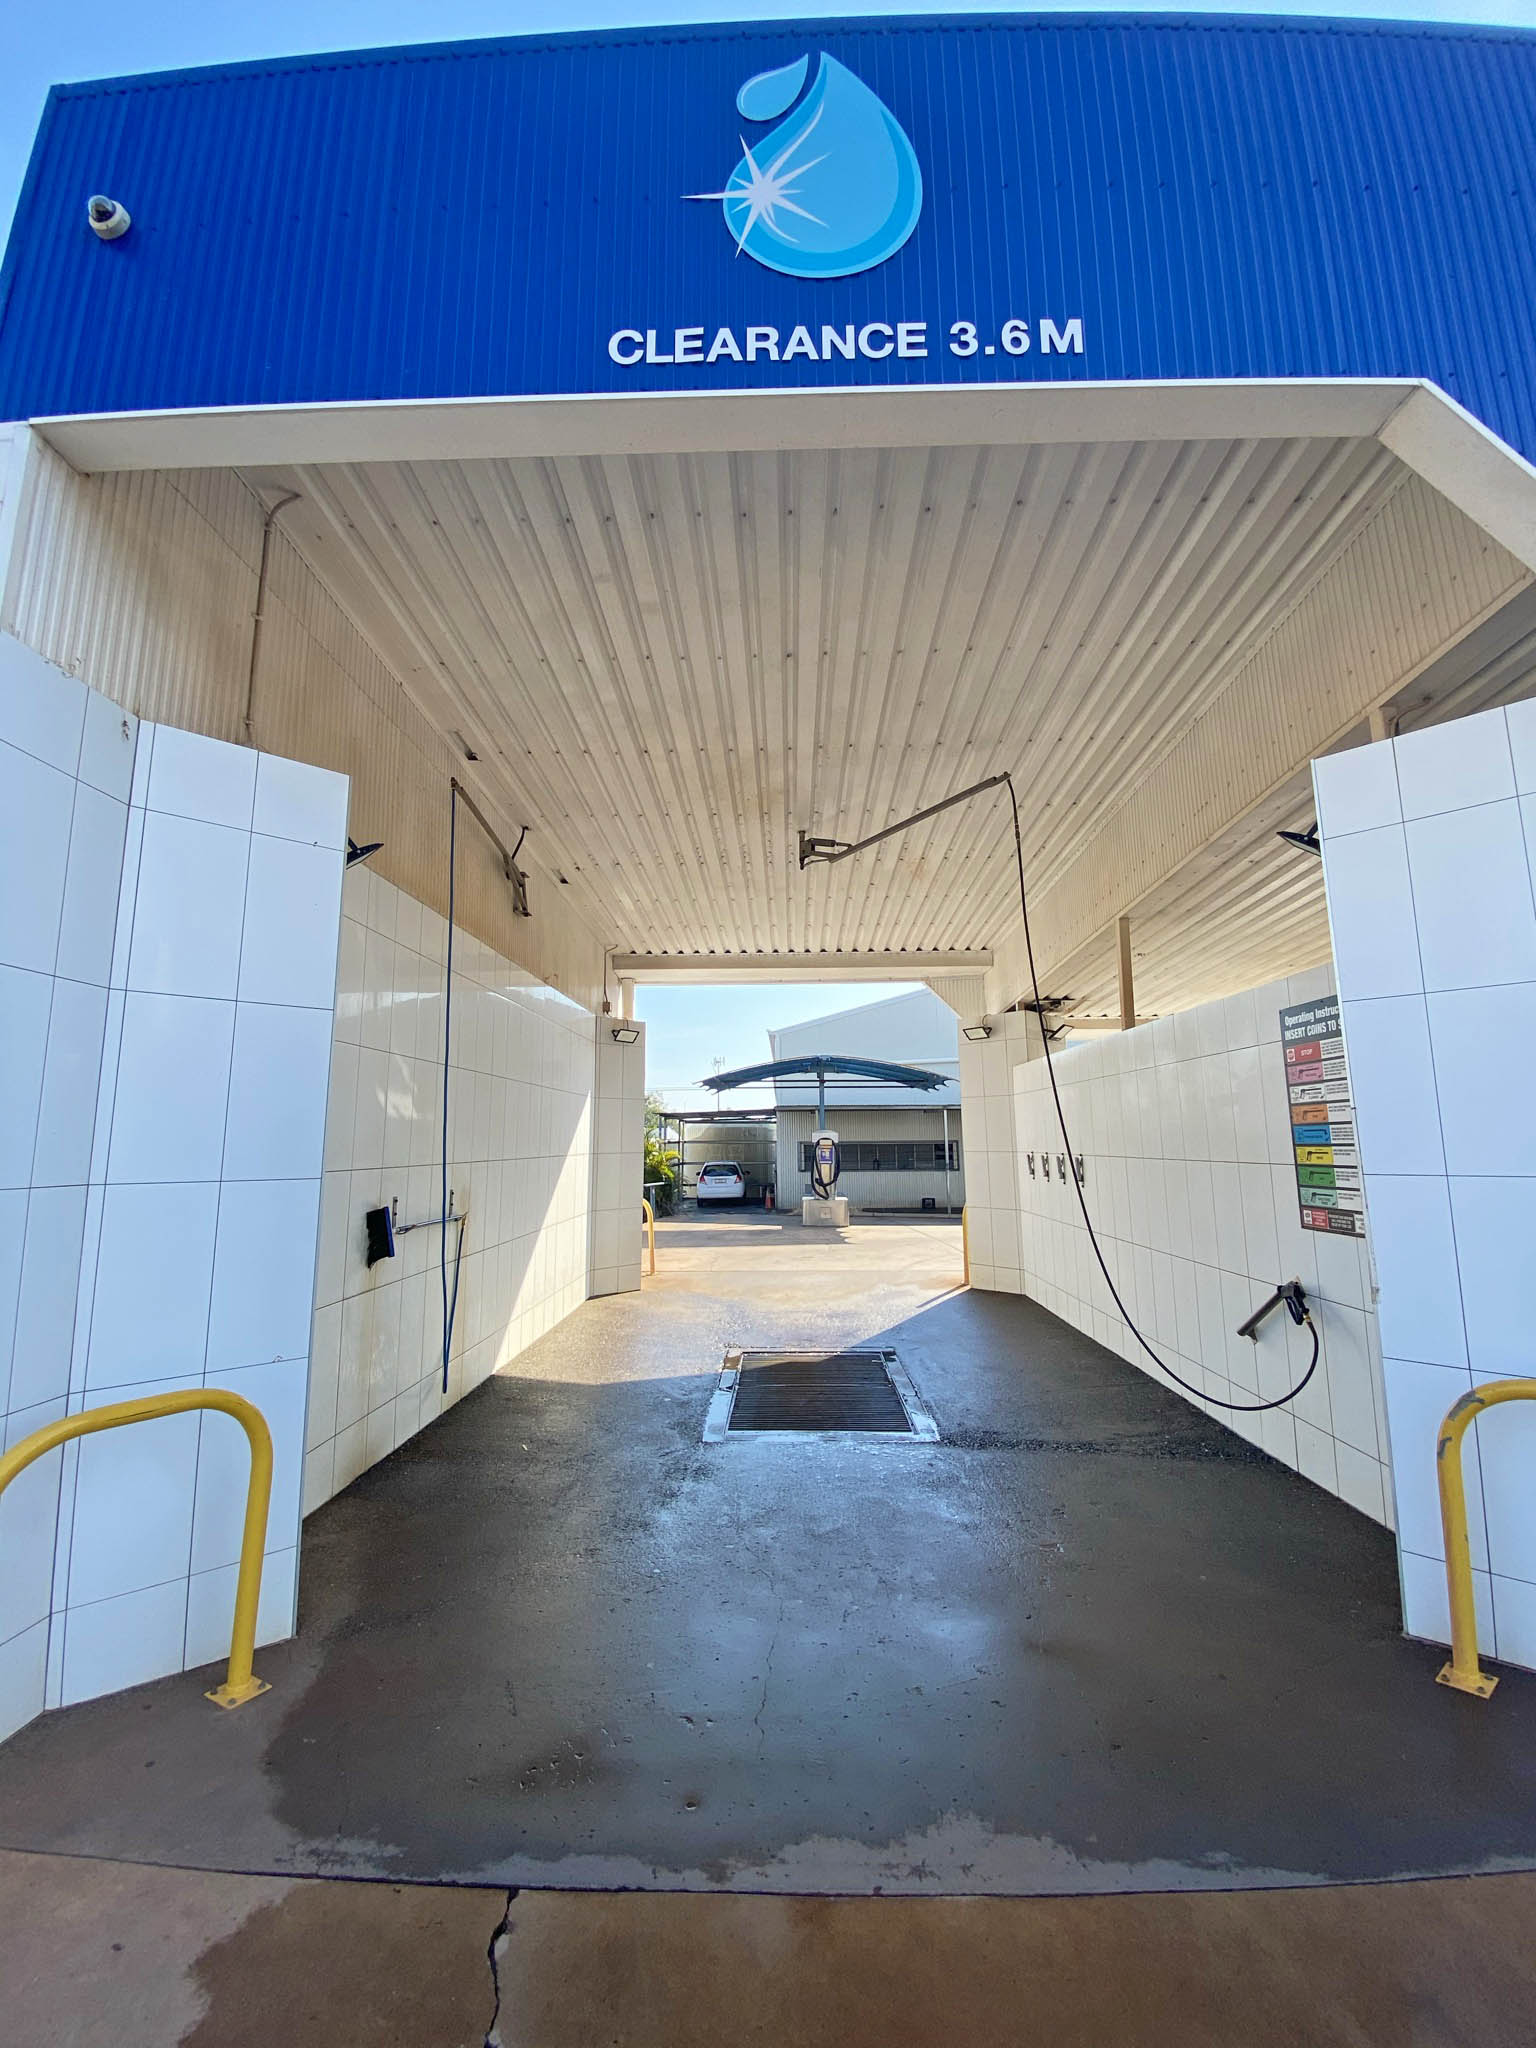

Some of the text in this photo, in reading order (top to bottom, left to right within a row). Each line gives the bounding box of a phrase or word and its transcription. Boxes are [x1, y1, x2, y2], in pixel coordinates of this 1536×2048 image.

[608, 318, 1085, 365] CLEARANCE 3.6M
[1284, 1011, 1315, 1028] Operating
[1284, 1026, 1306, 1040] INSERT
[1306, 1021, 1327, 1036] COINS
[1327, 1020, 1337, 1032] TO
